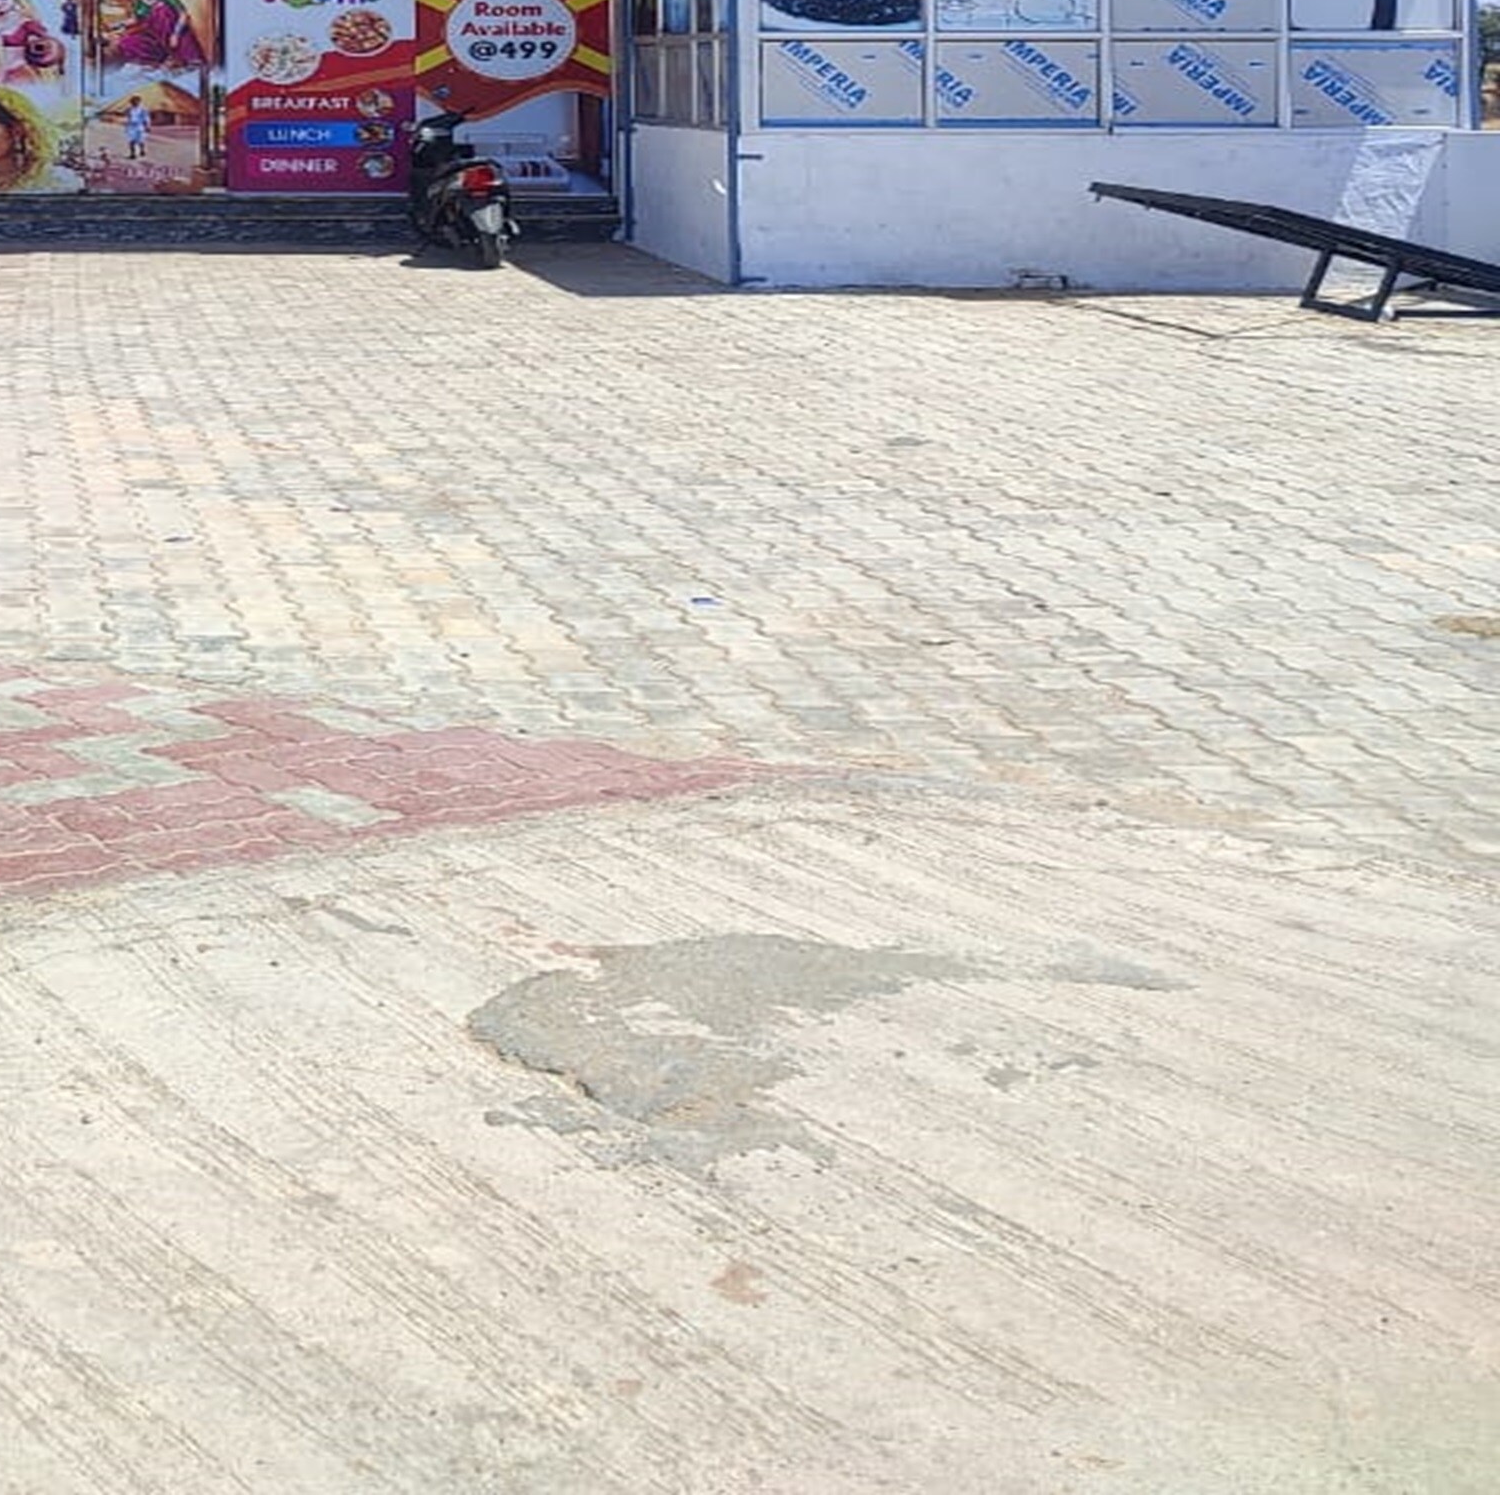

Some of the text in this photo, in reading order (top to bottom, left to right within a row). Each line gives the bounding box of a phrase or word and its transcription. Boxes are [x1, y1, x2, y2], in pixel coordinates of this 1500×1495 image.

[474, 2, 543, 17] Room
[460, 22, 566, 37] Available
[468, 40, 558, 61] @499
[780, 41, 867, 104] IMPERIA
[1004, 41, 1091, 106] IMPERIA
[251, 96, 351, 110] BREAKFAST
[267, 128, 333, 142] LUNCH
[260, 158, 338, 172] DINNER
